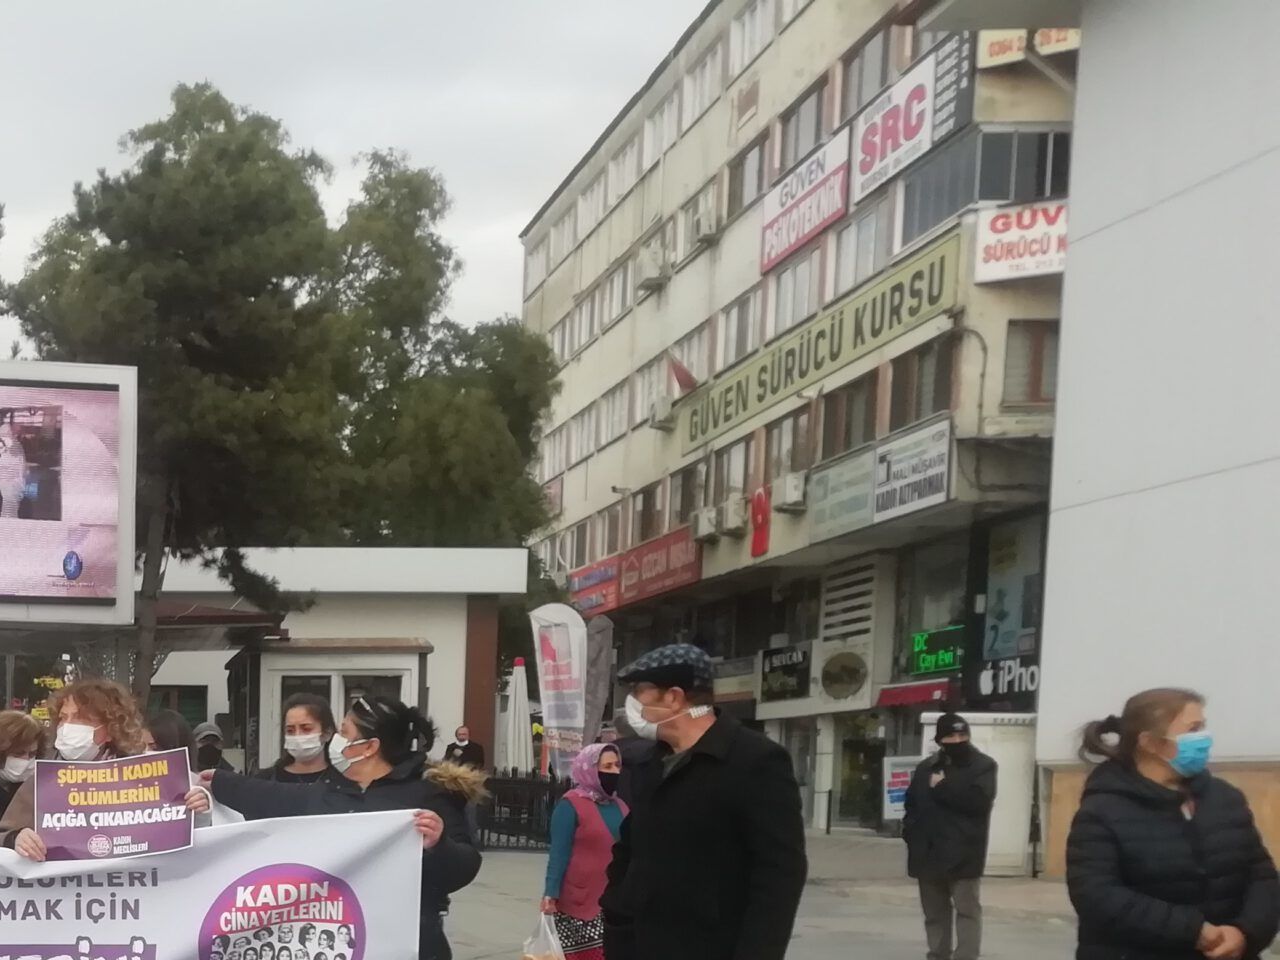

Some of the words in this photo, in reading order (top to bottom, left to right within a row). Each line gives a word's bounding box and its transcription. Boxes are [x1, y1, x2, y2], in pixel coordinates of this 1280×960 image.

[859, 83, 927, 175] SRC
[779, 150, 827, 209] GÜVEN
[990, 204, 1068, 234] GÜV
[982, 233, 1051, 264] SÜRÜCÜ
[689, 375, 750, 442] GÜVEN
[756, 309, 844, 403] SÜRÜCÜ
[853, 255, 946, 350] KURSU
[914, 633, 928, 652] DC
[998, 657, 1040, 694] iPho
[57, 763, 120, 787] ŞÜPHELİ
[123, 760, 168, 781] KADIN
[68, 782, 160, 806] ÖLÜMLERİNİ
[42, 809, 88, 831] AÇIĞA
[89, 803, 187, 830] ÇIKARACAĞIZ
[74, 891, 140, 924] İÇİN
[235, 881, 330, 908] KADIN
[220, 896, 343, 932] CİNAYETLERİNİ
